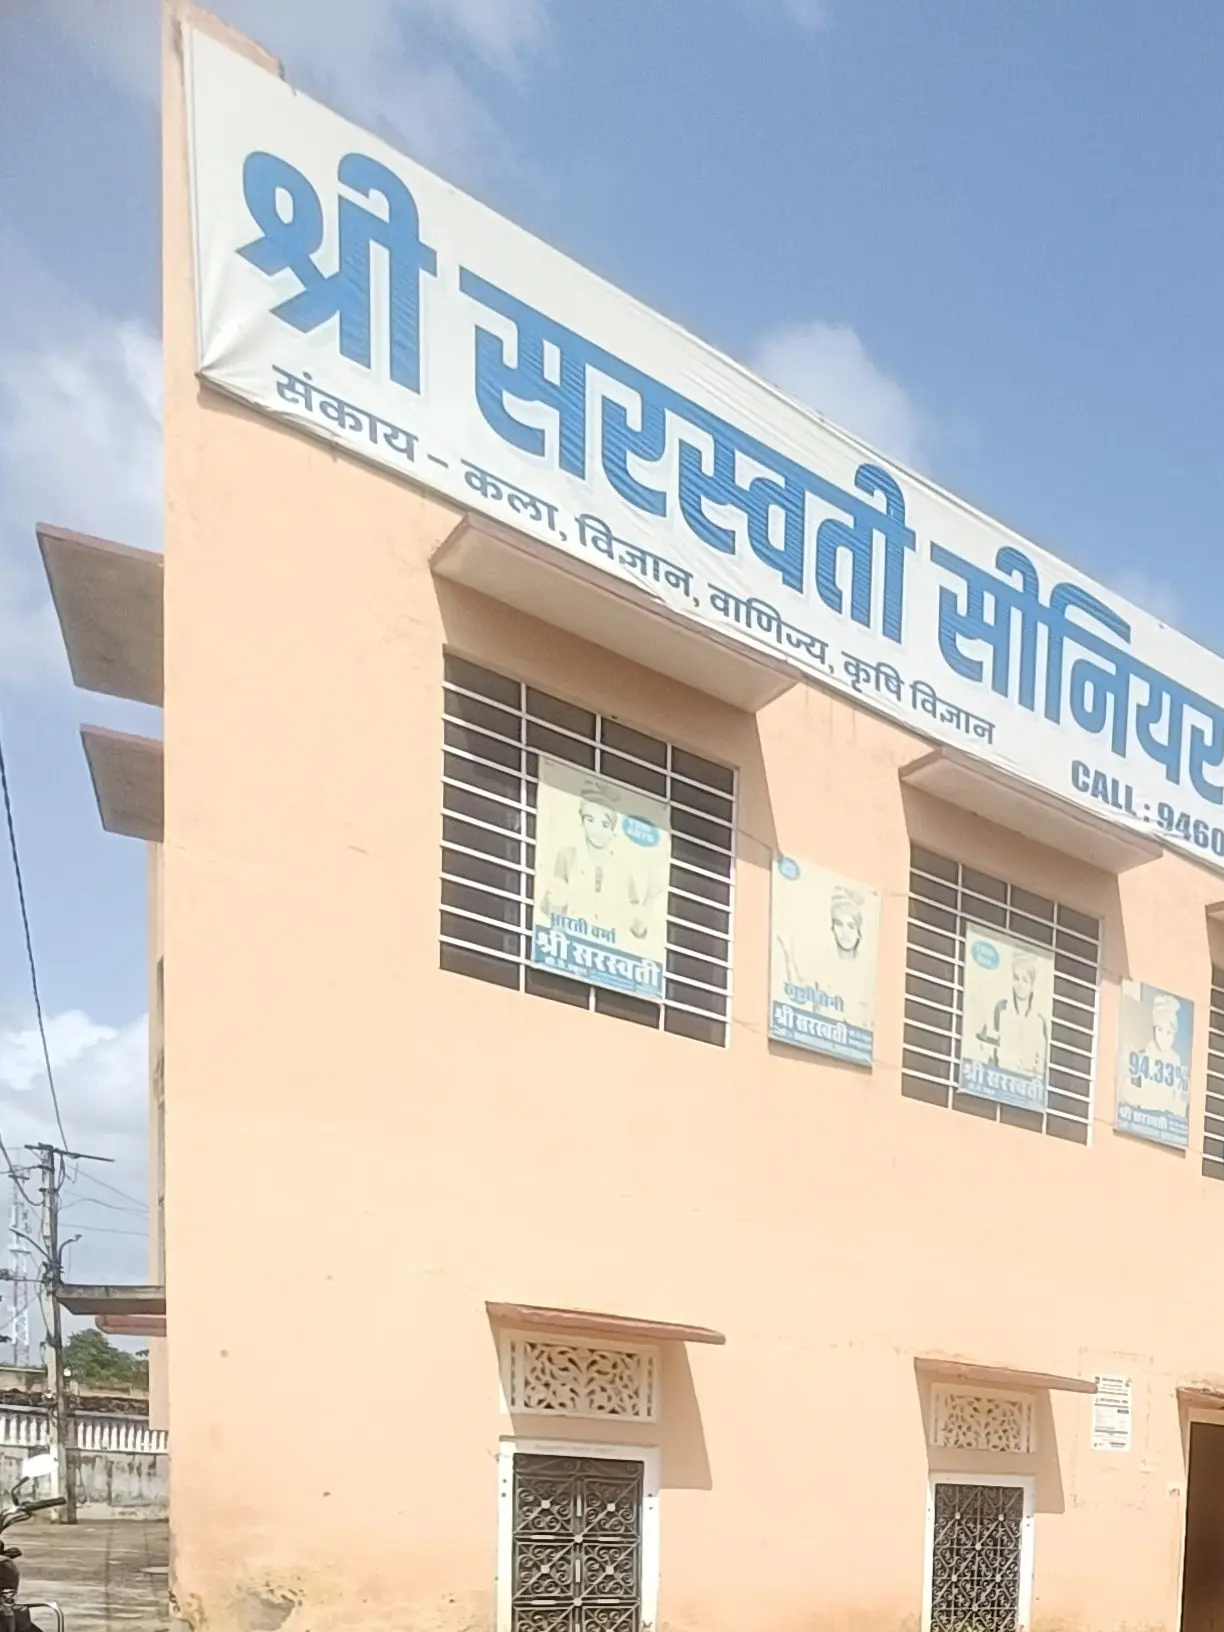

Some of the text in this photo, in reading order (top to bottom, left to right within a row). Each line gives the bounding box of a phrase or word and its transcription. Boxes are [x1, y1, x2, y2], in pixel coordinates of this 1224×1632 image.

[235, 150, 437, 394] श्री
[459, 265, 916, 645] सरस्वती
[272, 364, 419, 463] संकाय
[461, 458, 568, 542] कला,
[575, 513, 701, 608] विज्ञान,
[707, 582, 835, 675] वाणिज्य,
[841, 650, 905, 702] कृषि
[909, 680, 996, 746] विज्ञान
[1071, 759, 1137, 817] CALL
[537, 928, 571, 961] श्री
[571, 940, 662, 987] सरस्वती
